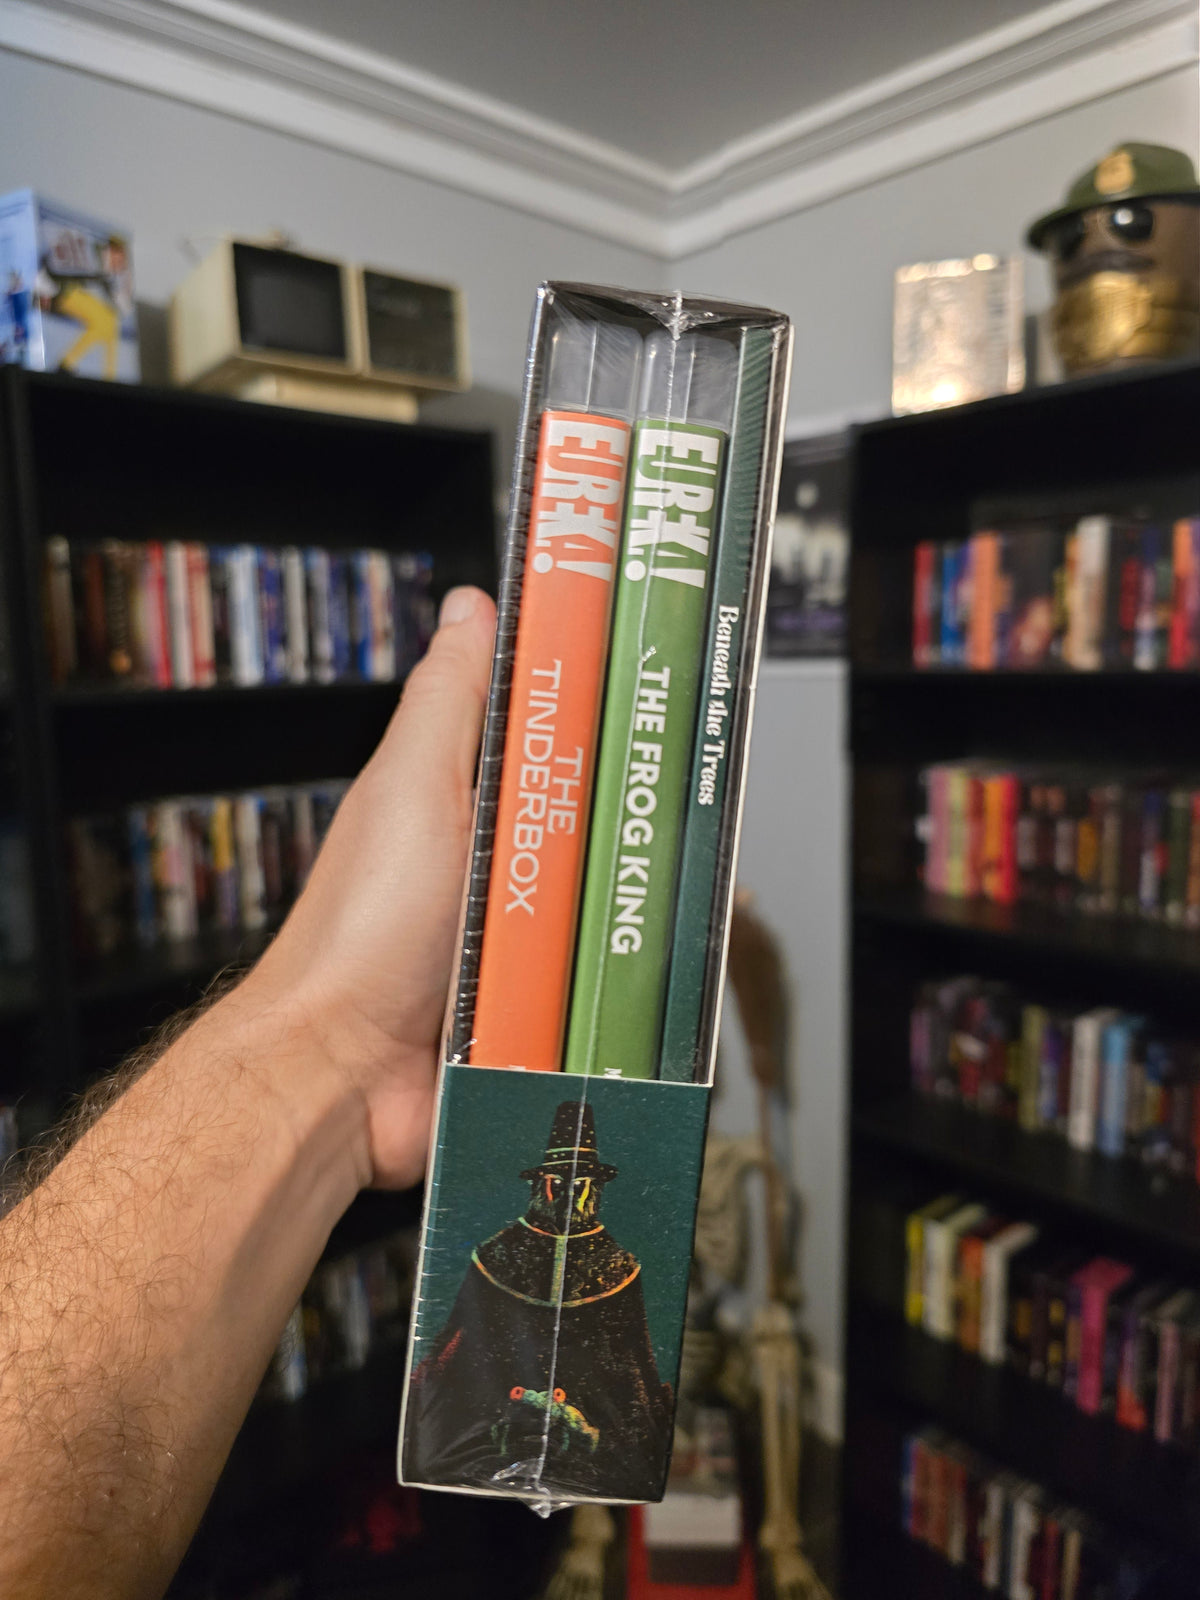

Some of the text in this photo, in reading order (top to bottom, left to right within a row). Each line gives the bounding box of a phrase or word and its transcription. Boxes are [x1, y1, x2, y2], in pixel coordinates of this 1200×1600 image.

[505, 659, 562, 917] TINDERBOX
[547, 746, 584, 836] THE
[611, 666, 671, 955] THE FROG KING
[698, 605, 740, 806] Beneath the Trees
